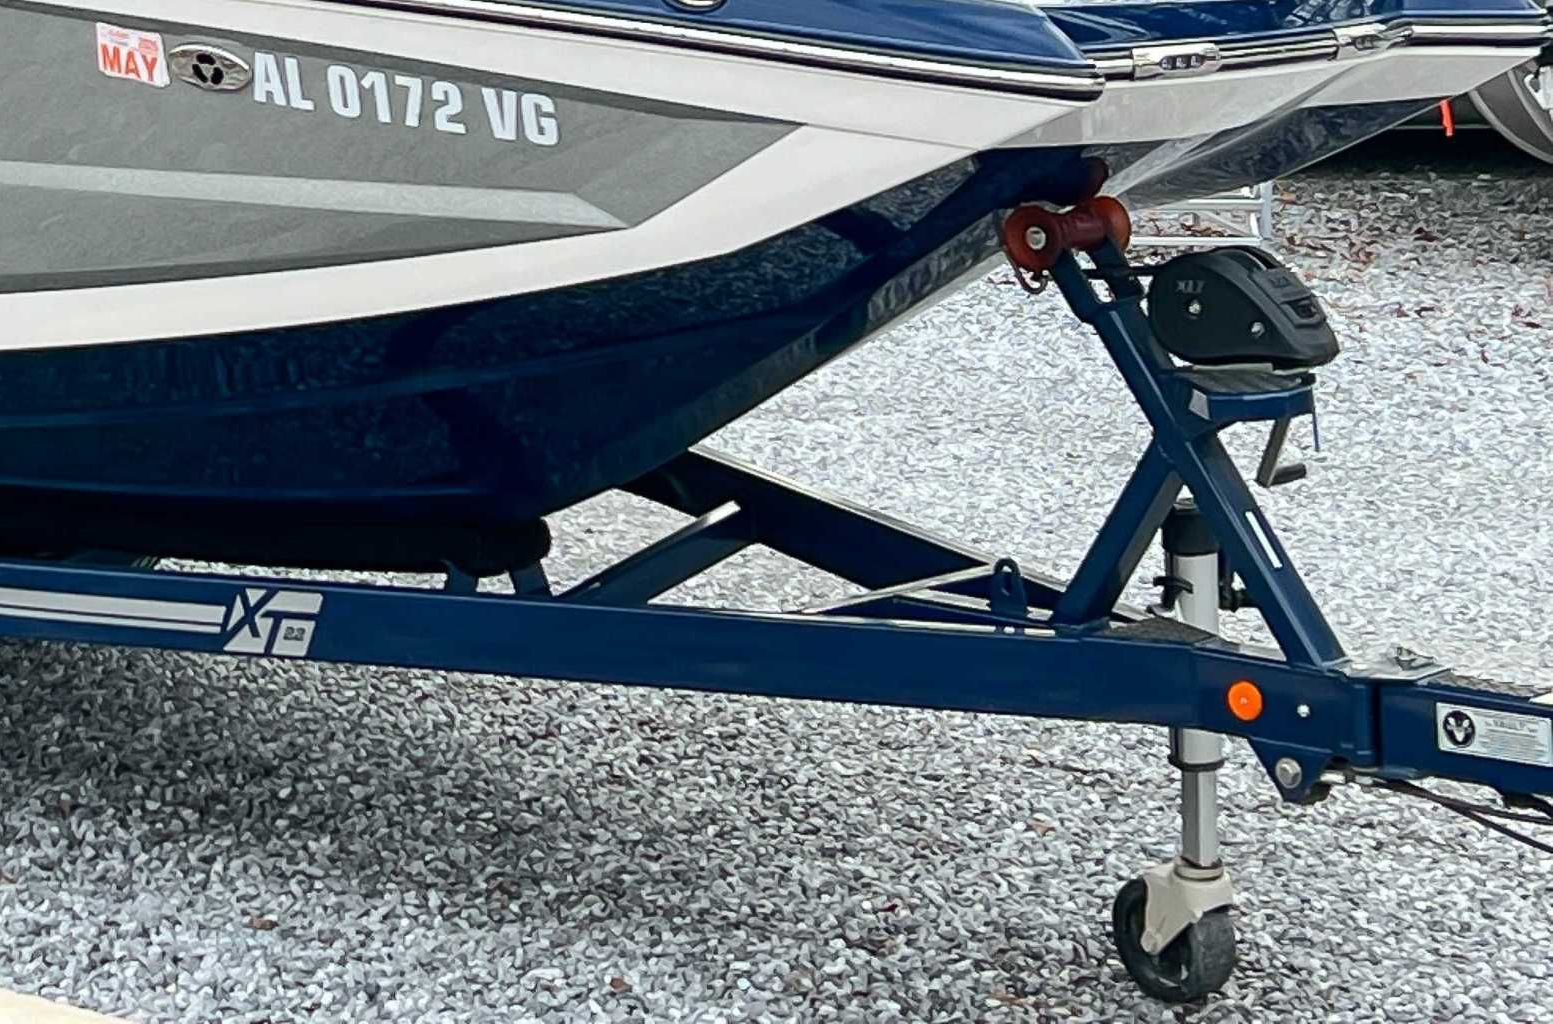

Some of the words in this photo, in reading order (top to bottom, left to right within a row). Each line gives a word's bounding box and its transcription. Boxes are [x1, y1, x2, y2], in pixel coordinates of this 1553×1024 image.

[100, 42, 158, 82] MAY
[253, 51, 315, 111] AL
[326, 64, 467, 135] 0172
[481, 87, 560, 146] VG
[283, 626, 307, 642] 22
